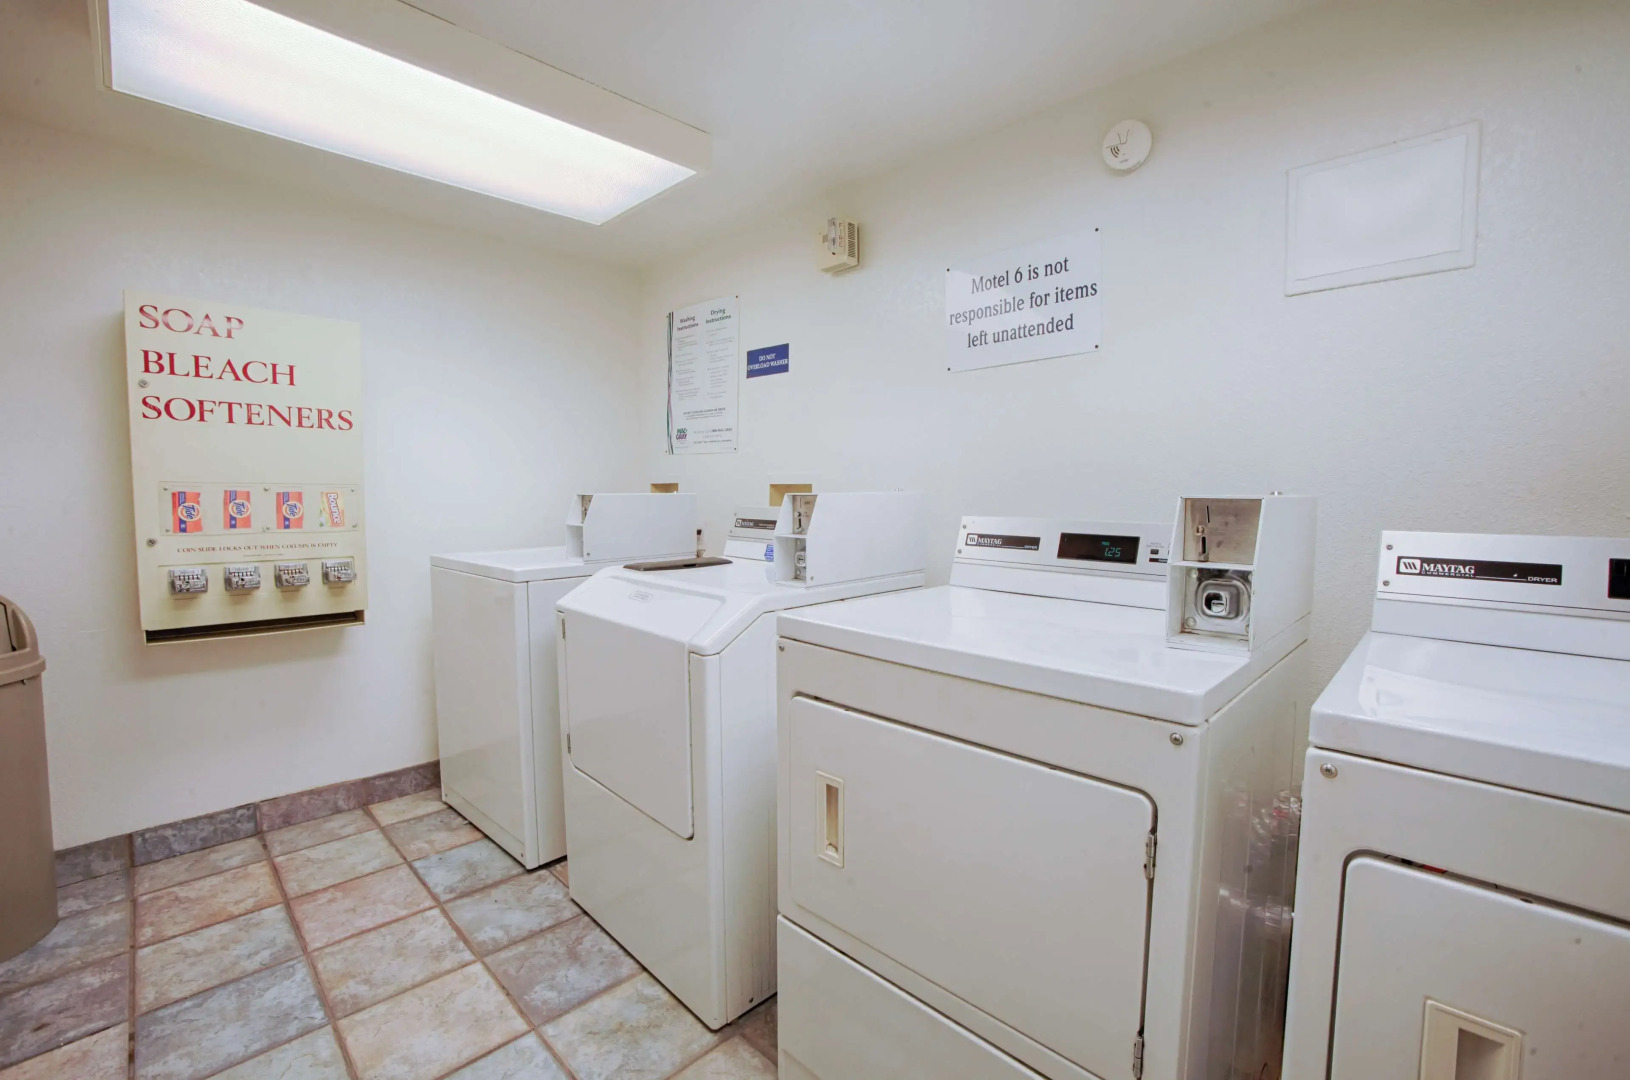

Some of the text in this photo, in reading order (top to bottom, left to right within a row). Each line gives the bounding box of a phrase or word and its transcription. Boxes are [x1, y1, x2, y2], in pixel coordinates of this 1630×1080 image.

[971, 257, 1070, 294] Motel 6 is not
[949, 282, 1098, 325] responsible for items
[710, 308, 726, 316] Drying
[138, 304, 244, 339] SOAP
[967, 313, 1074, 348] left unattended
[139, 349, 297, 386] BLEACH
[141, 395, 354, 431] SOFTENERS
[182, 504, 196, 520] Tide
[233, 501, 246, 517] Tide
[286, 502, 298, 518] Tide
[977, 537, 1003, 545] MAYTAG
[1421, 570, 1475, 578] COMMERCIAL
[1422, 562, 1475, 575] MAYTAG
